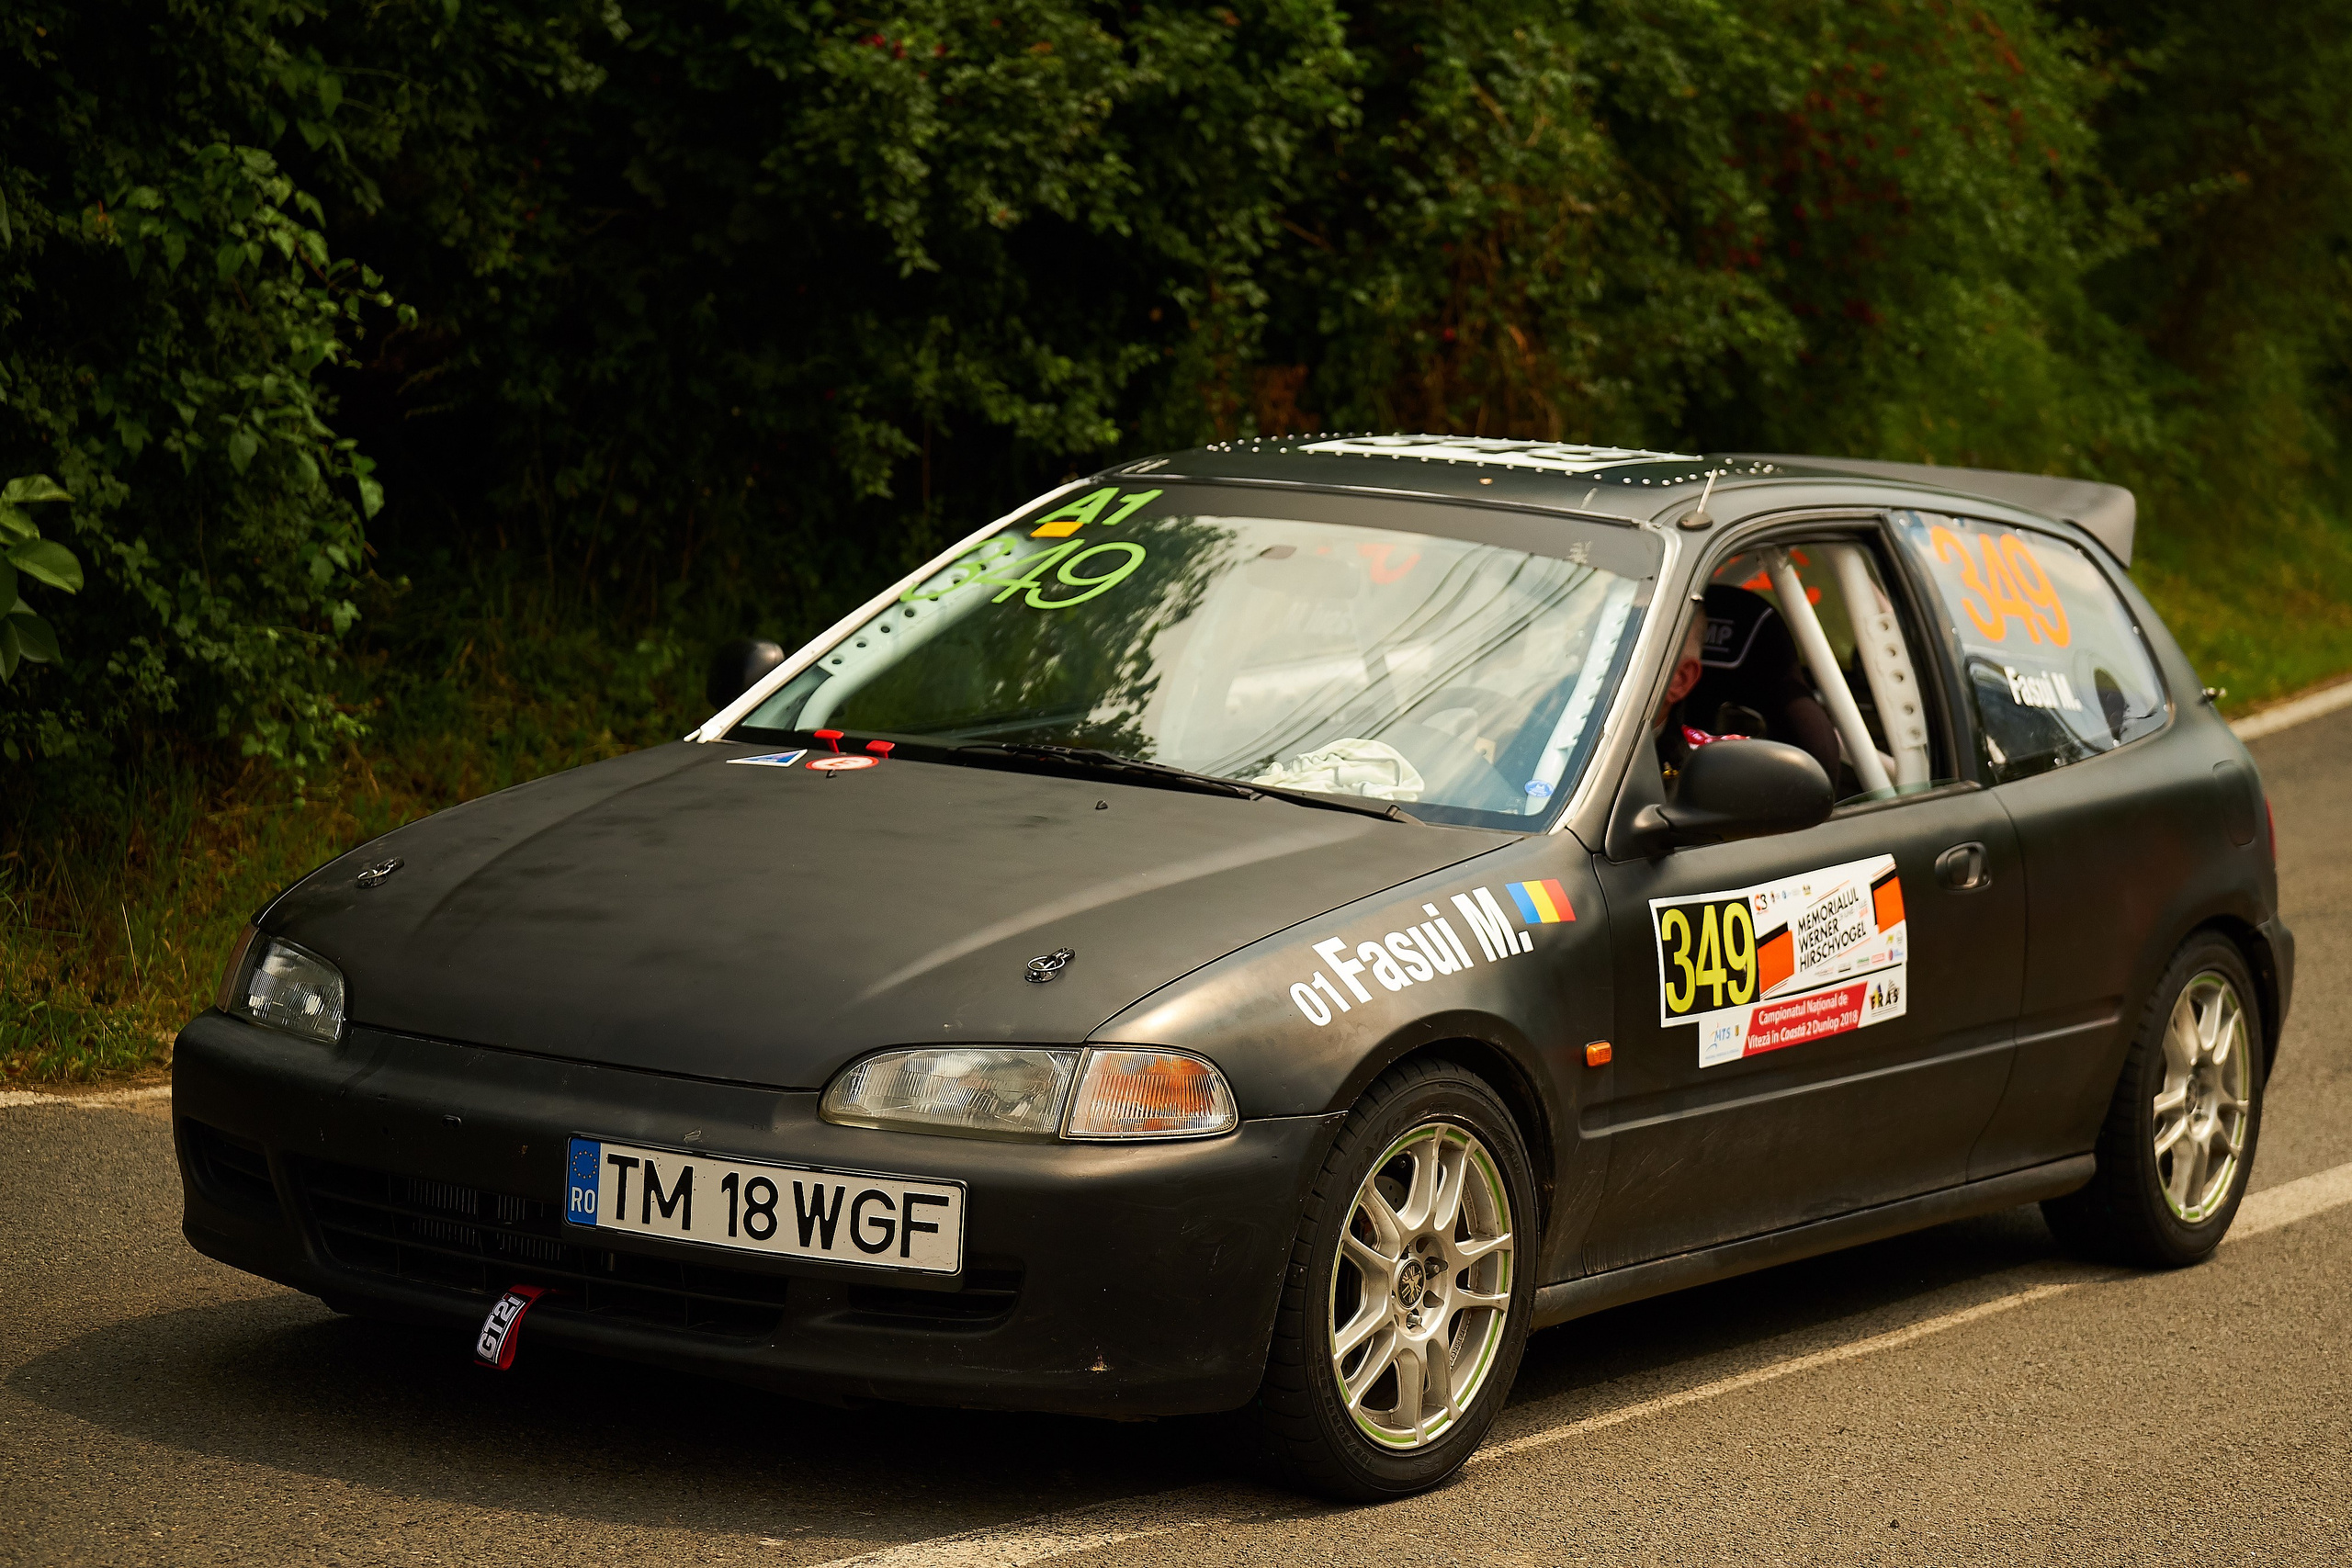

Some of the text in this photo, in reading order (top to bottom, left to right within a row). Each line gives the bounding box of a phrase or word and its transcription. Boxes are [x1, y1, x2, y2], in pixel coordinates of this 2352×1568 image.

[1035, 487, 1163, 525] A1
[899, 536, 1147, 609] 349
[1930, 525, 2071, 649] 349
[1798, 887, 1859, 935] MEMORIALUL
[1799, 918, 1838, 953] WERNER
[1311, 902, 1475, 1004] Fasui
[1450, 886, 1534, 963] M.
[1661, 902, 1757, 1013] 349
[1800, 920, 1866, 972] HIRSCHVOGEL
[1758, 999, 1805, 1025] Campionatul
[1838, 991, 1849, 1008] de
[1812, 1016, 1839, 1034] Dunlop
[1839, 1010, 1859, 1027] 2018
[571, 1186, 596, 1214] RO
[606, 1153, 950, 1258] TM 18 WGF
